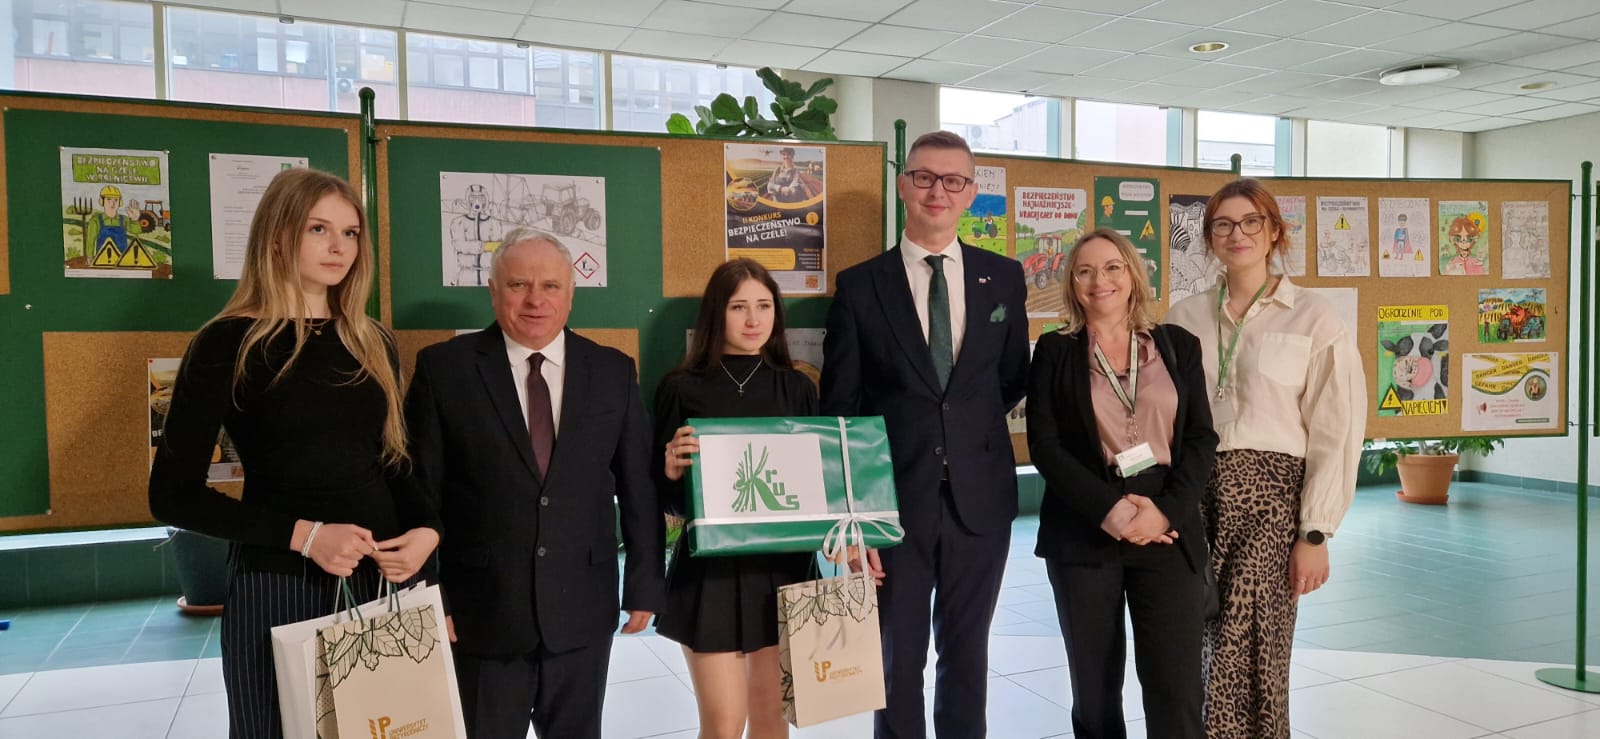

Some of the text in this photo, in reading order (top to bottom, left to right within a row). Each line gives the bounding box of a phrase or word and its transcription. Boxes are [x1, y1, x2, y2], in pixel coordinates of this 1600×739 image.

[748, 211, 782, 223] KONKURS
[745, 234, 759, 243] NA
[1430, 308, 1444, 318] POD
